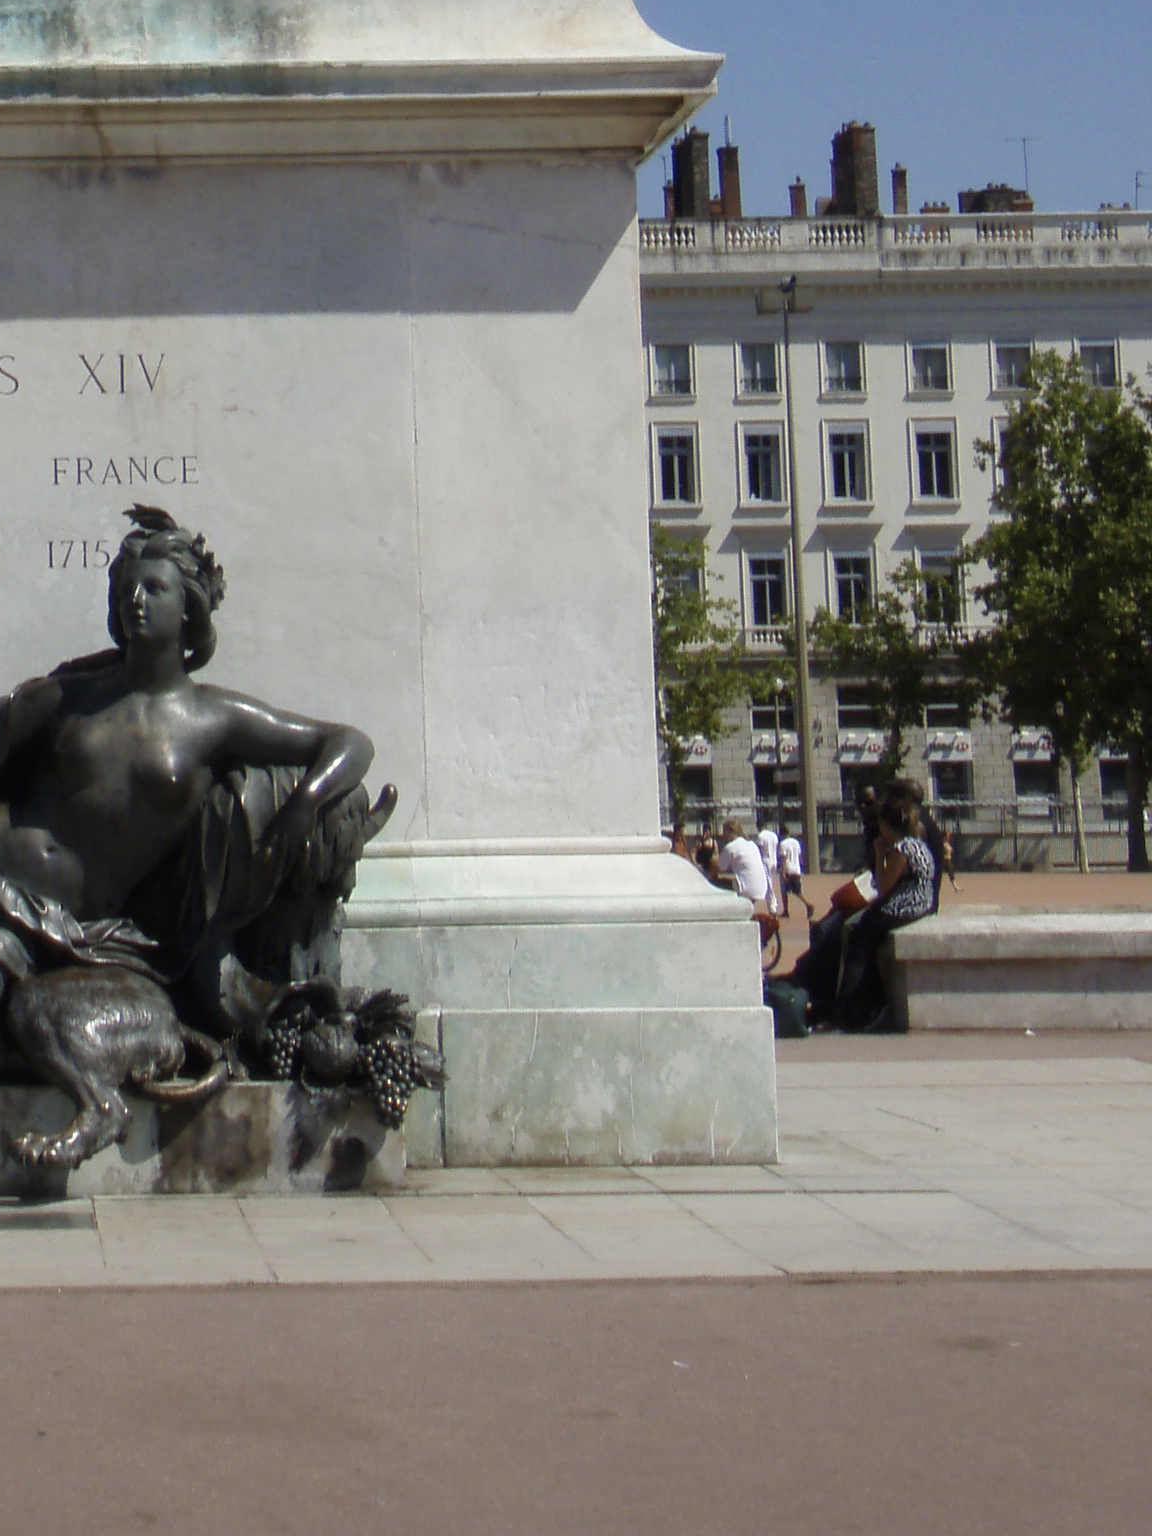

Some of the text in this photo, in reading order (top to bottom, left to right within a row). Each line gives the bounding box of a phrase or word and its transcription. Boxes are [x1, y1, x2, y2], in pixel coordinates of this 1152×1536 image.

[78, 353, 165, 395] XIV
[53, 455, 199, 486] FRANCE
[47, 540, 110, 569] 1715
